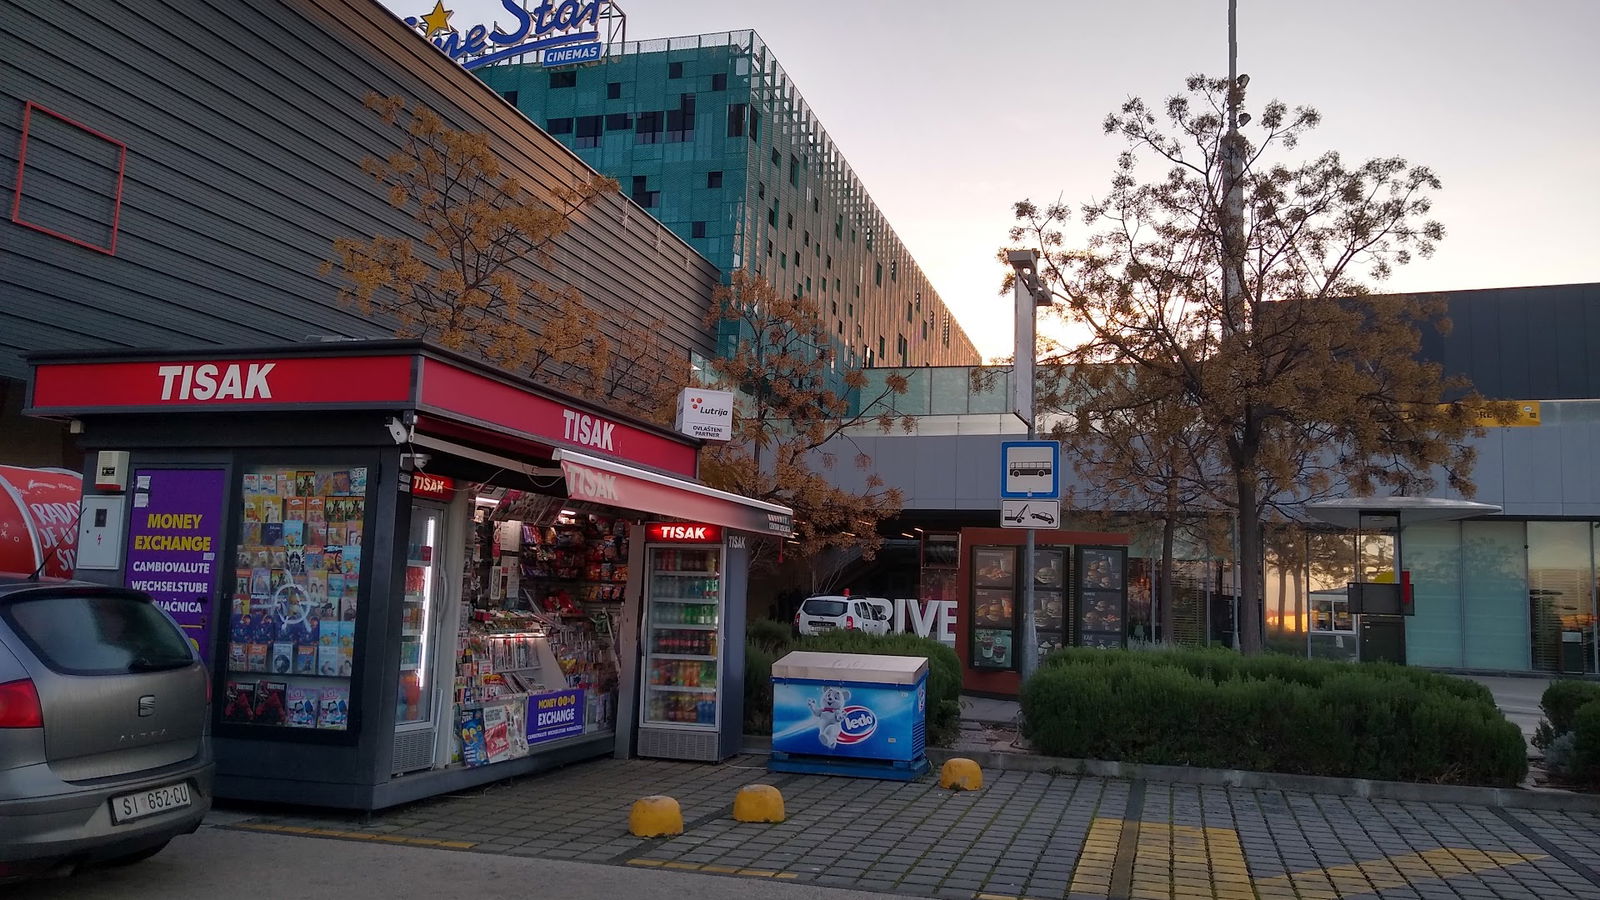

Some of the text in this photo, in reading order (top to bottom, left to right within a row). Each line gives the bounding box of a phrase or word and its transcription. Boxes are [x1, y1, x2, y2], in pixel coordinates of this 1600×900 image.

[546, 46, 597, 62] CINEMAS
[158, 363, 276, 401] TISAK
[700, 406, 728, 417] Lutrija
[563, 409, 615, 451] TISAK
[413, 475, 445, 494] TISAK
[567, 465, 619, 500] TISAK
[147, 513, 203, 529] MONEY
[661, 526, 707, 539] TISAK
[134, 535, 212, 552] EXCHANGE
[728, 535, 747, 549] TISAK
[133, 561, 210, 574] CAMBIOVALUTE
[131, 580, 208, 593] WECHSELSTUBE
[539, 698, 558, 709] MONEY
[537, 708, 575, 726] EXCHANGE
